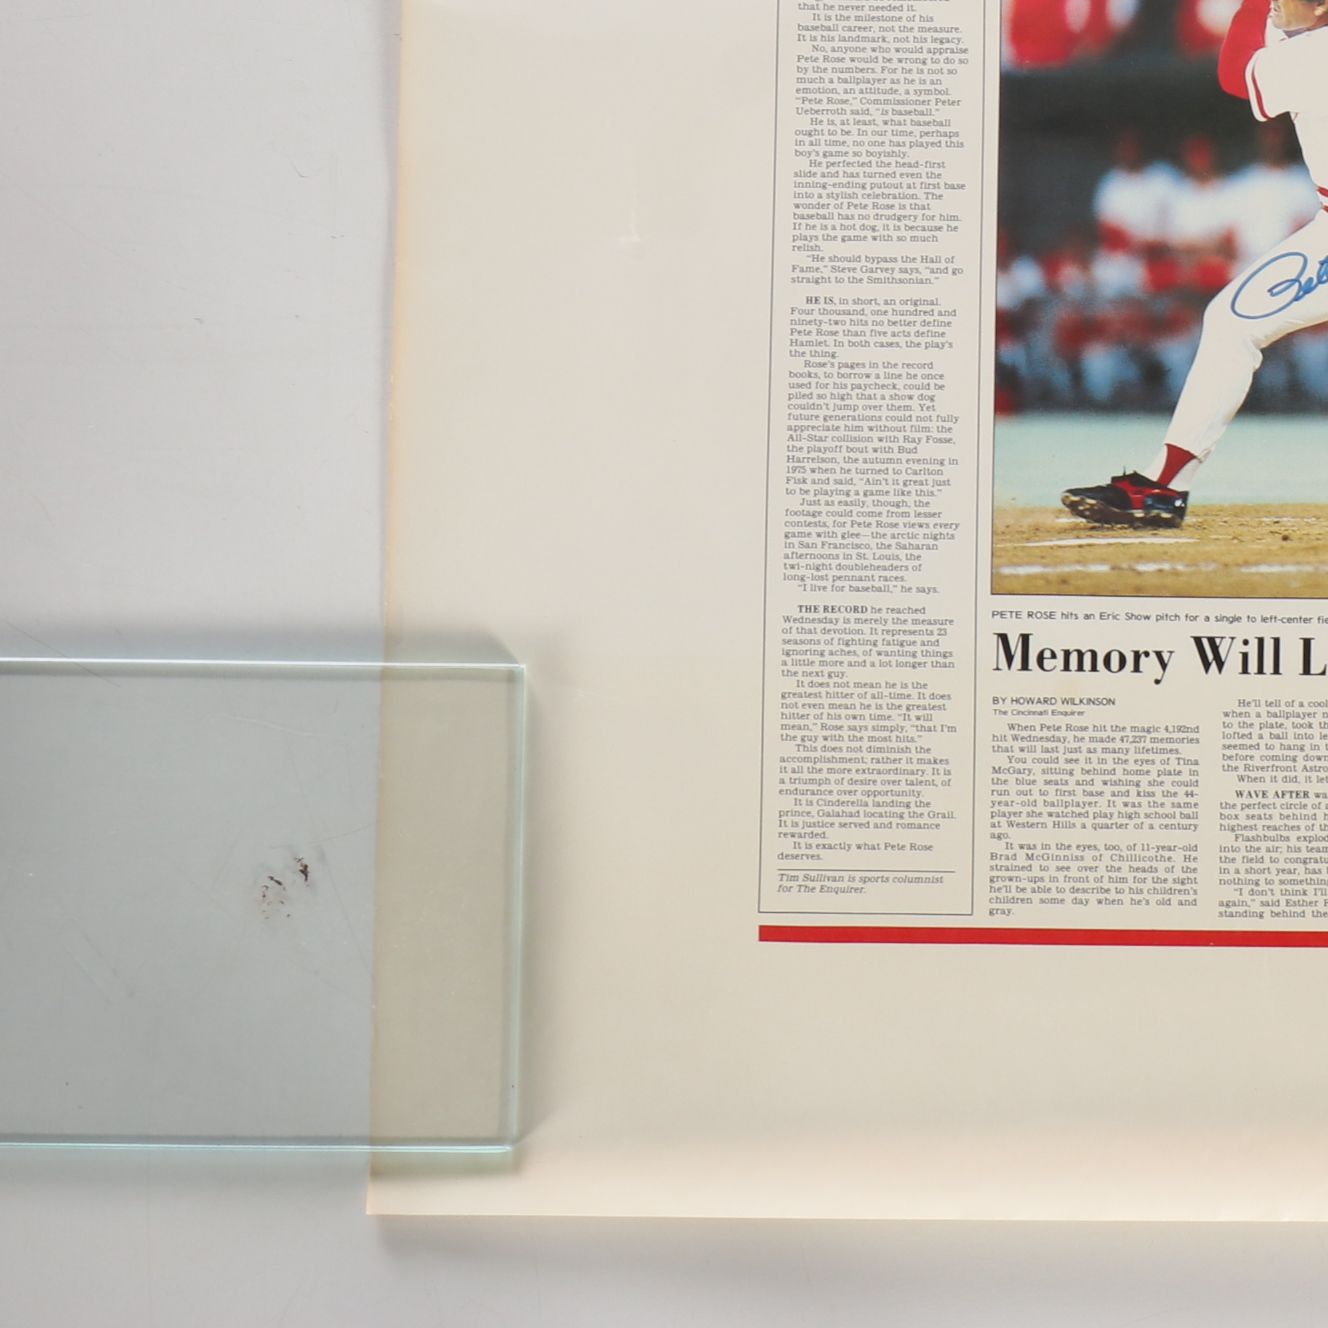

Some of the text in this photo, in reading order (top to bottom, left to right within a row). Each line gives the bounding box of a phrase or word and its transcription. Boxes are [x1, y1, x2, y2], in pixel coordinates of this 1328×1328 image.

[797, 604, 869, 615] THE RECORD
[991, 609, 1023, 620] PETE
[1026, 610, 1057, 620] ROSE
[1060, 610, 1080, 621] hits
[1082, 613, 1096, 621] an
[1098, 611, 1121, 622] Eric
[1124, 611, 1152, 622] Show
[1155, 612, 1181, 623] pitch
[1184, 612, 1200, 623] for
[1203, 615, 1211, 623] a
[1213, 613, 1243, 625] single
[1246, 614, 1258, 624] to
[1260, 614, 1314, 625] left-center
[992, 632, 1175, 686] Memory
[1190, 635, 1283, 676] Will
[991, 695, 1116, 707] BY HOWARD WILKINSON
[1234, 789, 1311, 800] WAVE AFTER
